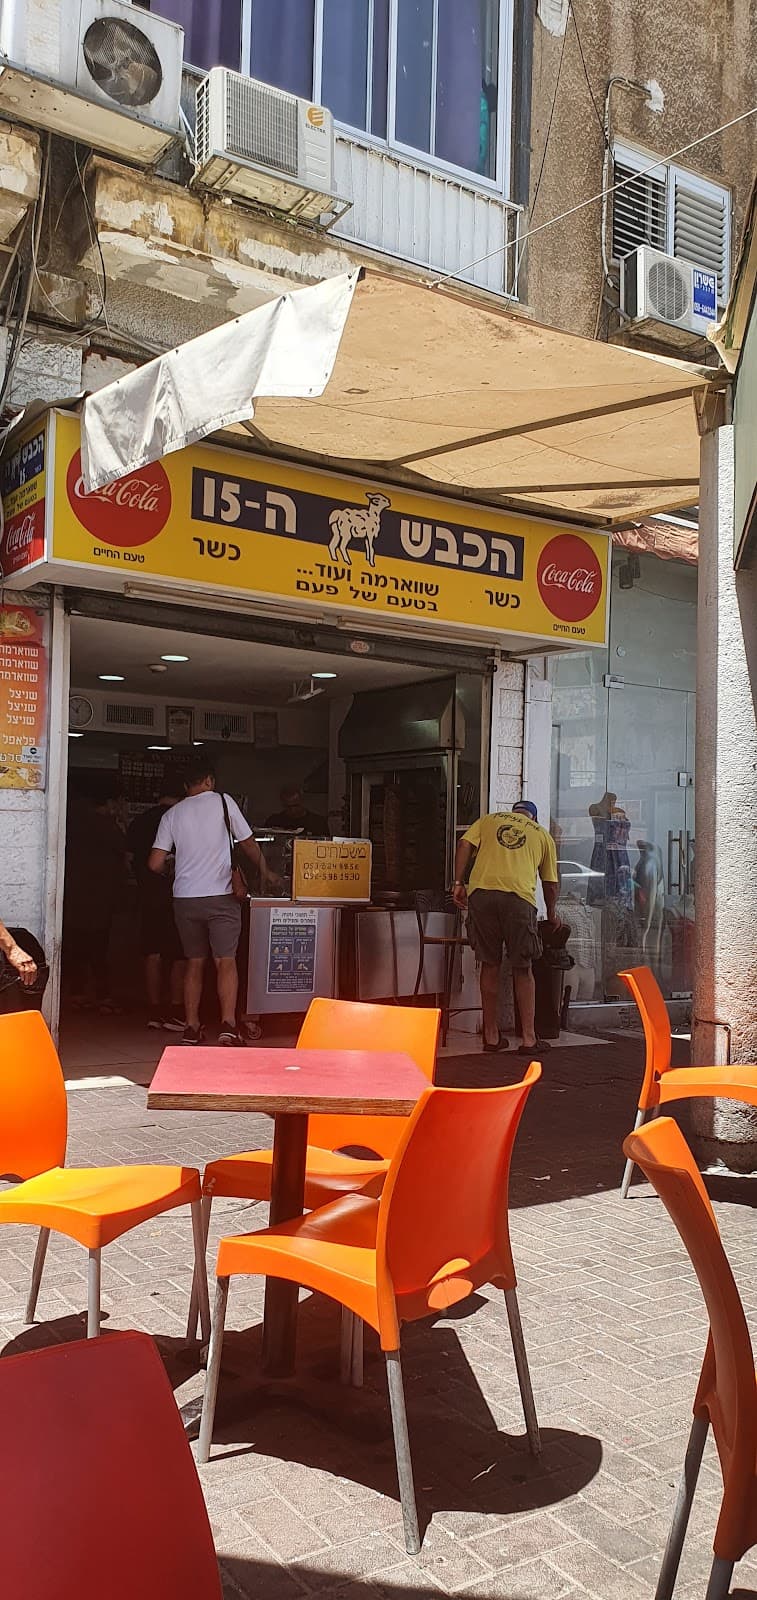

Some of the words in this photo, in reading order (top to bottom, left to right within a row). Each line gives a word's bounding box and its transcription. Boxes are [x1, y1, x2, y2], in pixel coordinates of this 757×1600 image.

[305, 123, 327, 136] ELECTRA
[22, 432, 44, 464] הכבש
[93, 547, 120, 559] החיים
[193, 537, 241, 561] כשר
[400, 519, 516, 575] הכבש
[124, 552, 145, 563] טעם
[296, 563, 352, 582] ועוד...
[541, 563, 597, 594] Coca-Cola
[296, 579, 339, 595] פעם
[360, 571, 440, 597] שווארמה
[349, 585, 378, 602] של
[484, 589, 521, 609] כשר
[387, 595, 439, 612] בטעם
[552, 623, 570, 633] החיים
[571, 626, 586, 634] טעם
[9, 688, 38, 700] שניצל
[7, 700, 37, 712] שניצל
[6, 713, 35, 725] שניצל
[2, 733, 36, 746] פלאפל
[316, 844, 367, 859] משלוחים
